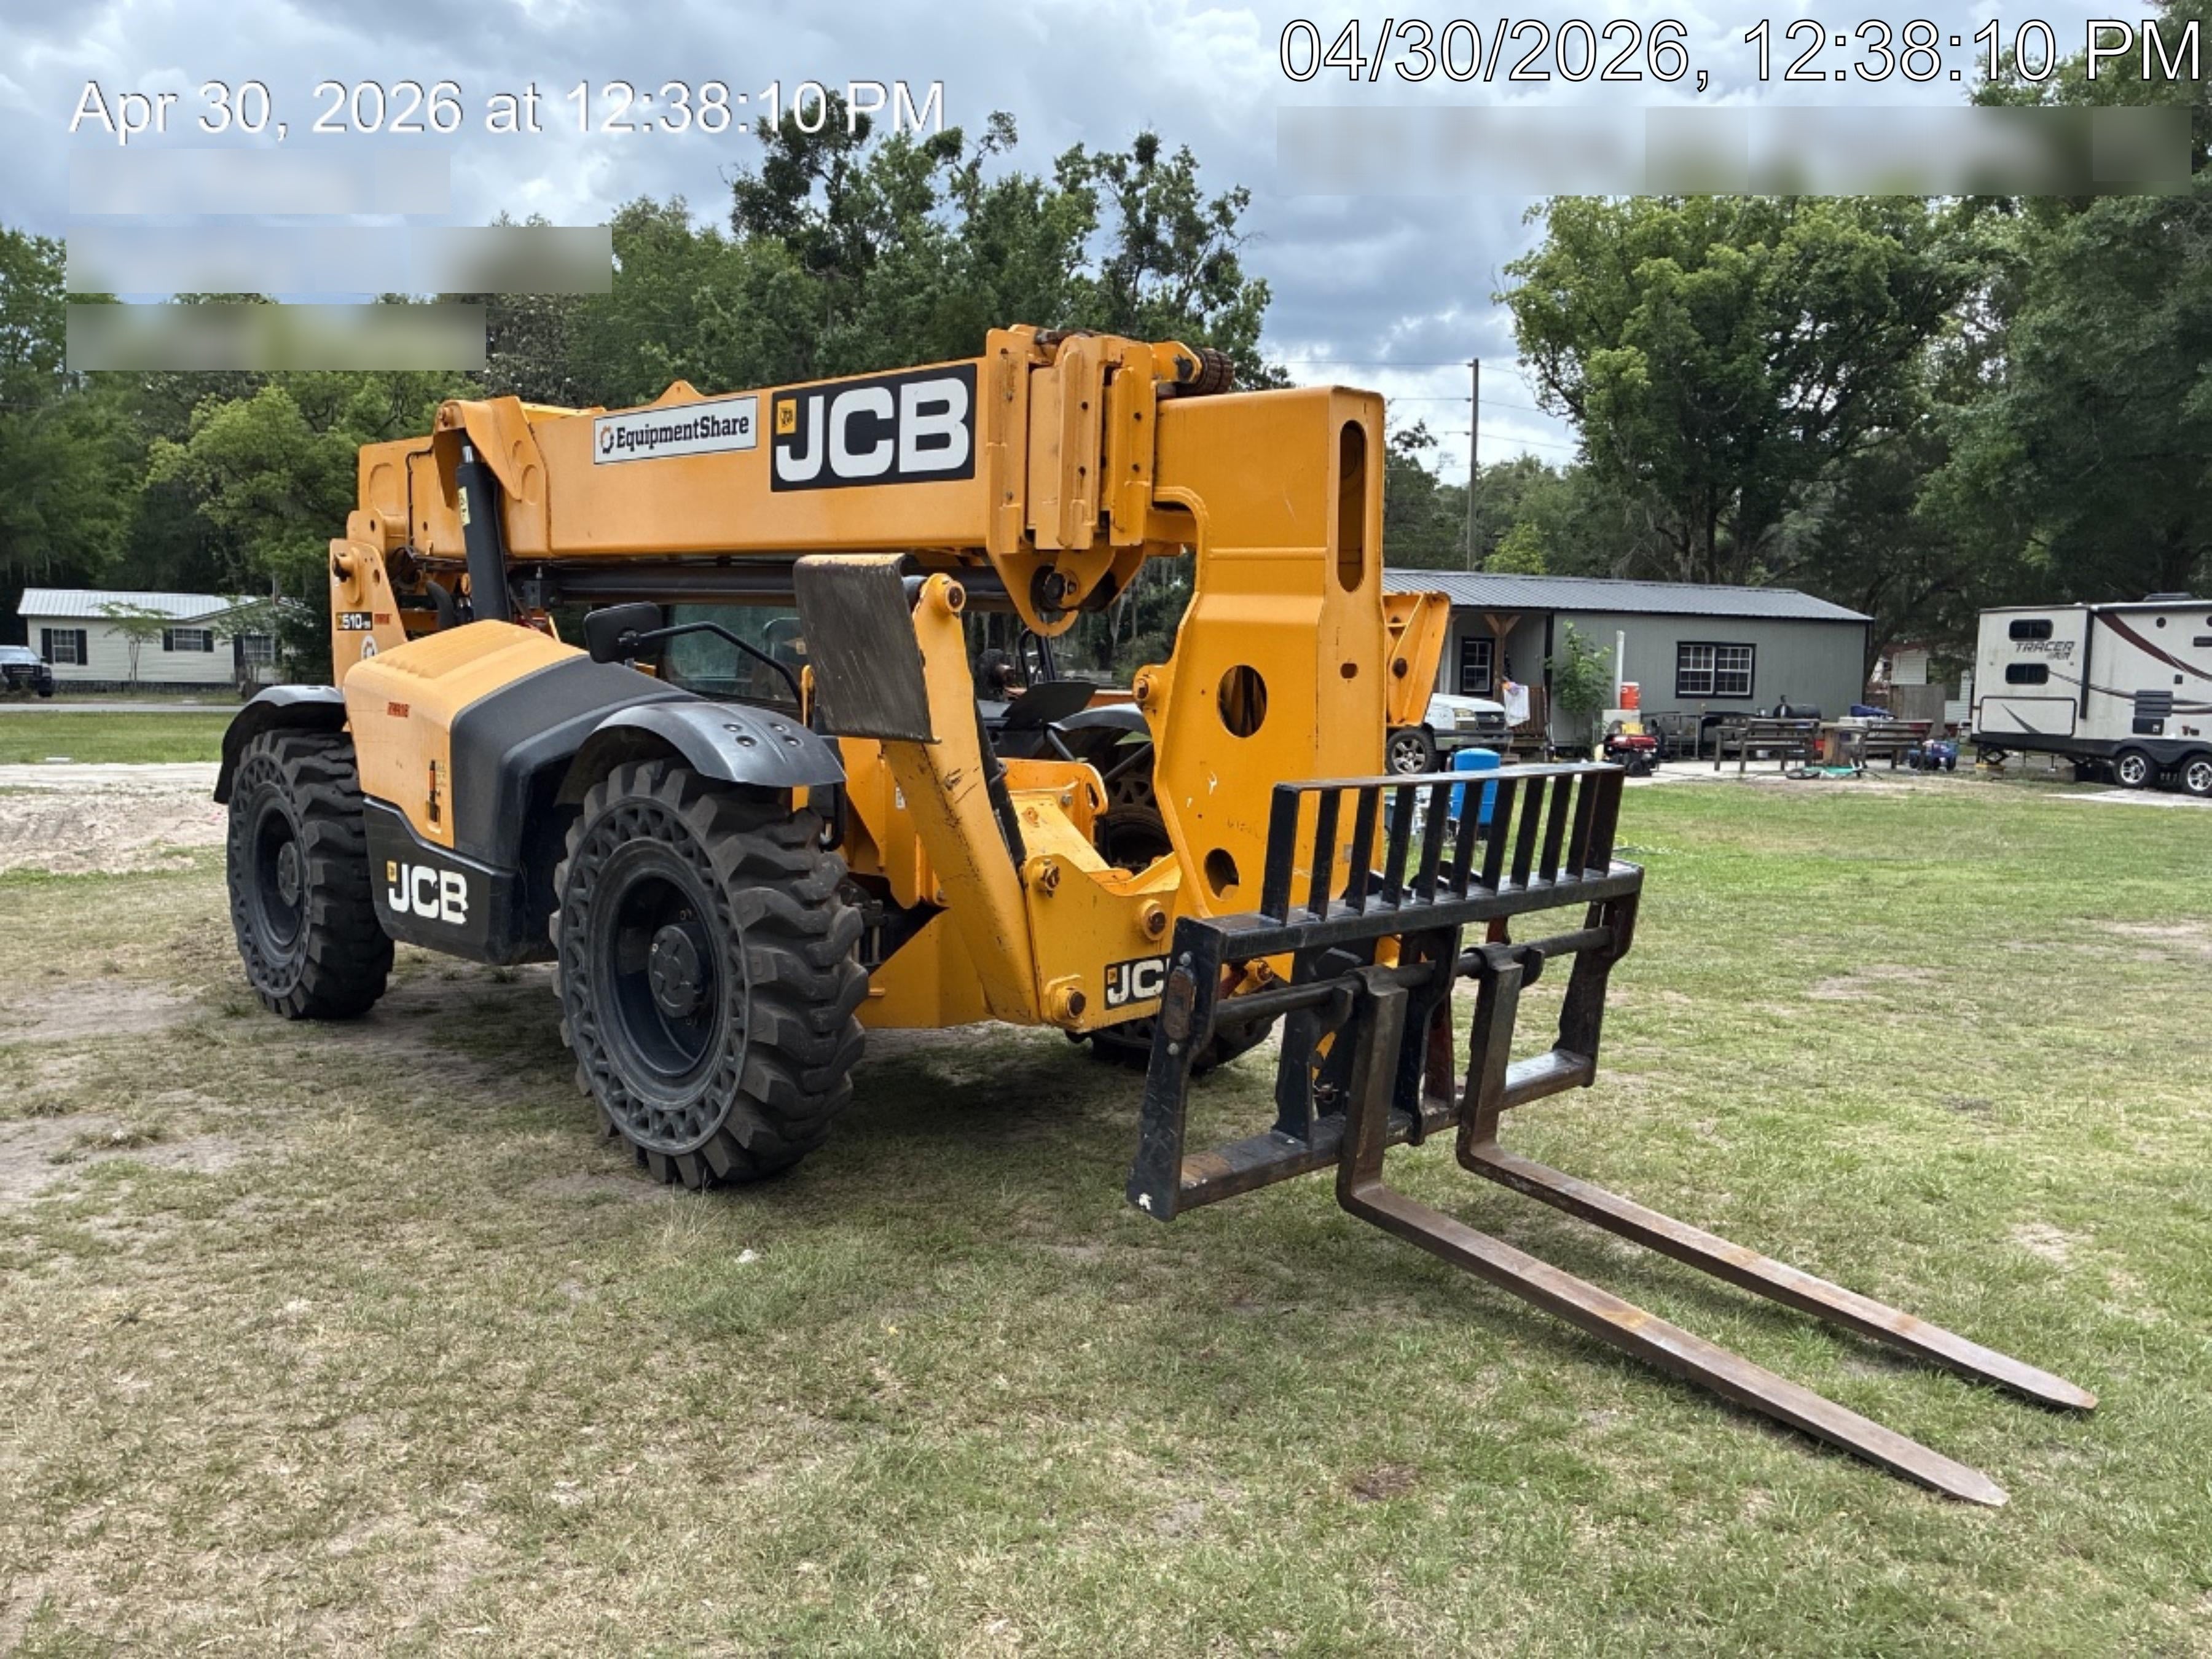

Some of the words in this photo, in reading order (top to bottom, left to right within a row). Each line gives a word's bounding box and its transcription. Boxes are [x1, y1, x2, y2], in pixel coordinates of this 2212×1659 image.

[616, 415, 749, 451] EquipmentShare
[776, 377, 970, 482] JCB
[2016, 641, 2075, 653] TRACER
[388, 863, 468, 924] JCB
[1107, 957, 1170, 1004] JC
